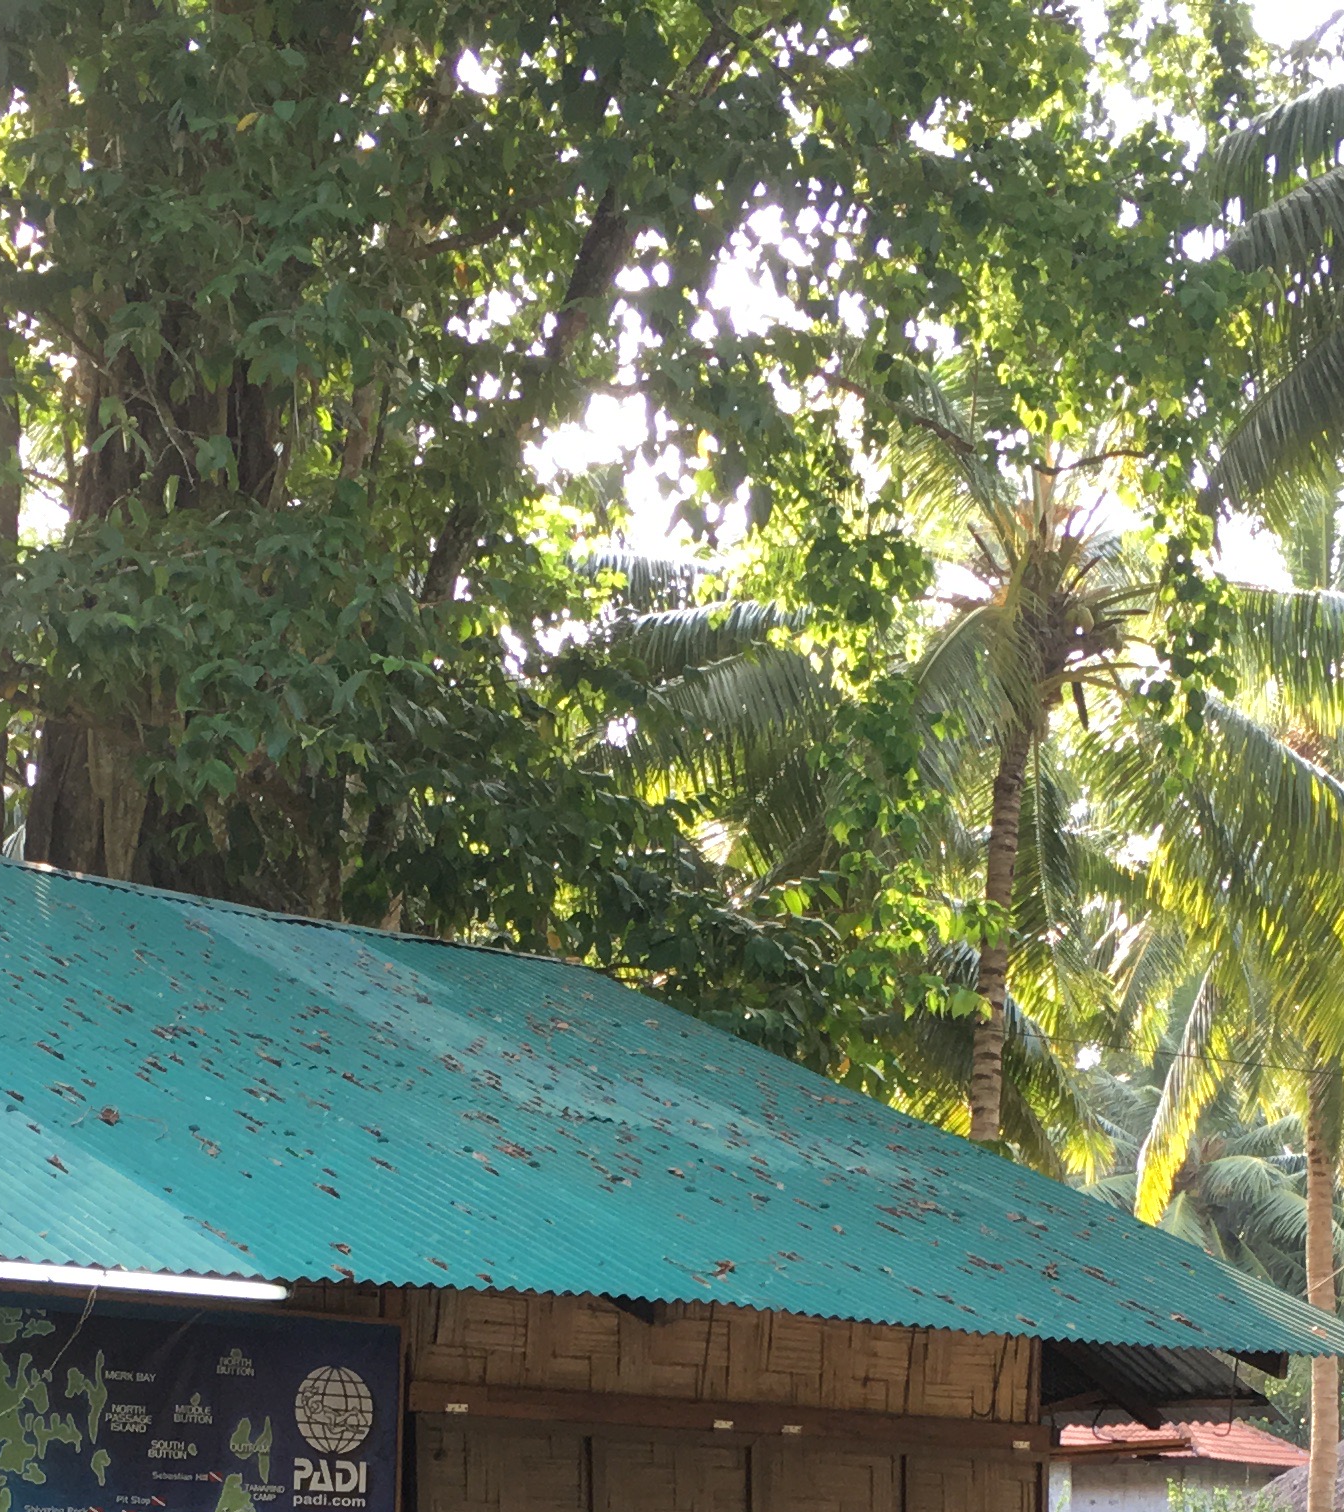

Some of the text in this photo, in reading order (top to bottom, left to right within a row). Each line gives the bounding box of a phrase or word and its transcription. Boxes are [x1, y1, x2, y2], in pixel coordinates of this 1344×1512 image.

[220, 1357, 252, 1367] NORTH
[216, 1365, 255, 1377] BUTTON
[136, 1373, 156, 1382] BAY
[112, 1404, 146, 1414] NORTH
[175, 1404, 211, 1415] MIDDLE
[105, 1413, 152, 1424] PASSAGE
[173, 1413, 212, 1424] BUTTON
[111, 1423, 147, 1433] ISLAND
[151, 1439, 185, 1450] SOUTH
[148, 1449, 187, 1460] BUTTON
[152, 1471, 209, 1482] Sebastian Hill
[294, 1458, 367, 1493] PADI
[244, 1483, 285, 1493] TAMARIND
[116, 1495, 151, 1506] Pit Stop
[253, 1493, 276, 1502] CAMP
[293, 1493, 366, 1507] padi.com
